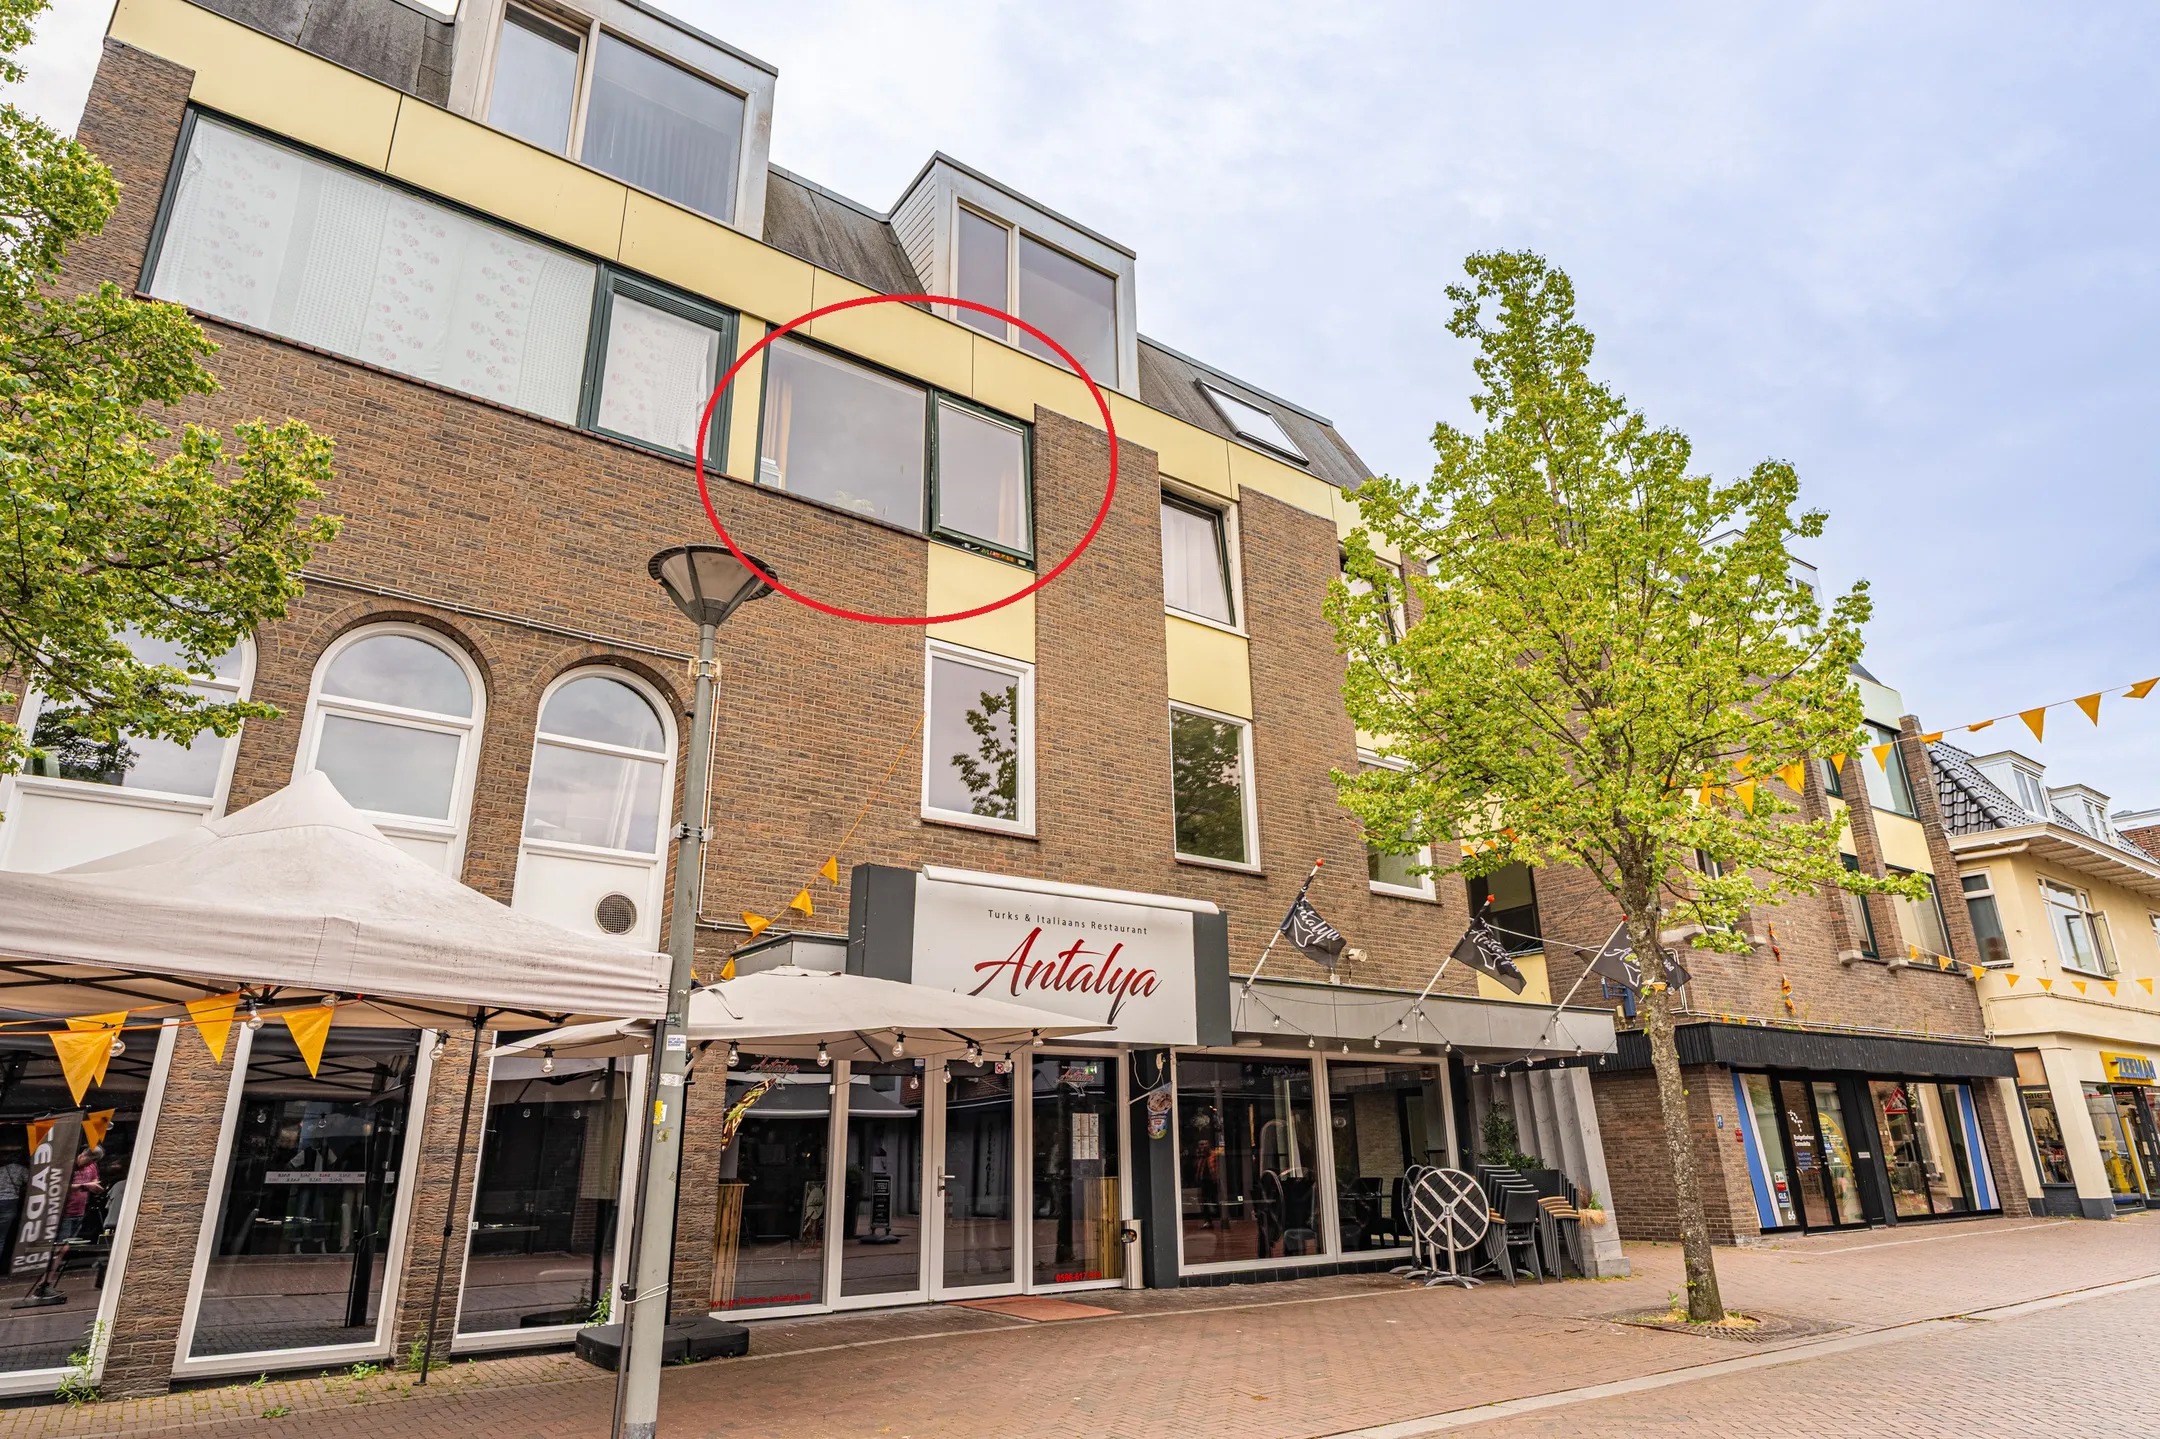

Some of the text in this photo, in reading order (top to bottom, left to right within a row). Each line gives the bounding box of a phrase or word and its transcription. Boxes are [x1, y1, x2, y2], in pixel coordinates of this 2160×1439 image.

[988, 909, 1148, 935] Turks & Italiaans Restaurant
[968, 926, 1163, 1026] Antalya
[2115, 1056, 2157, 1080] ZEEMAN
